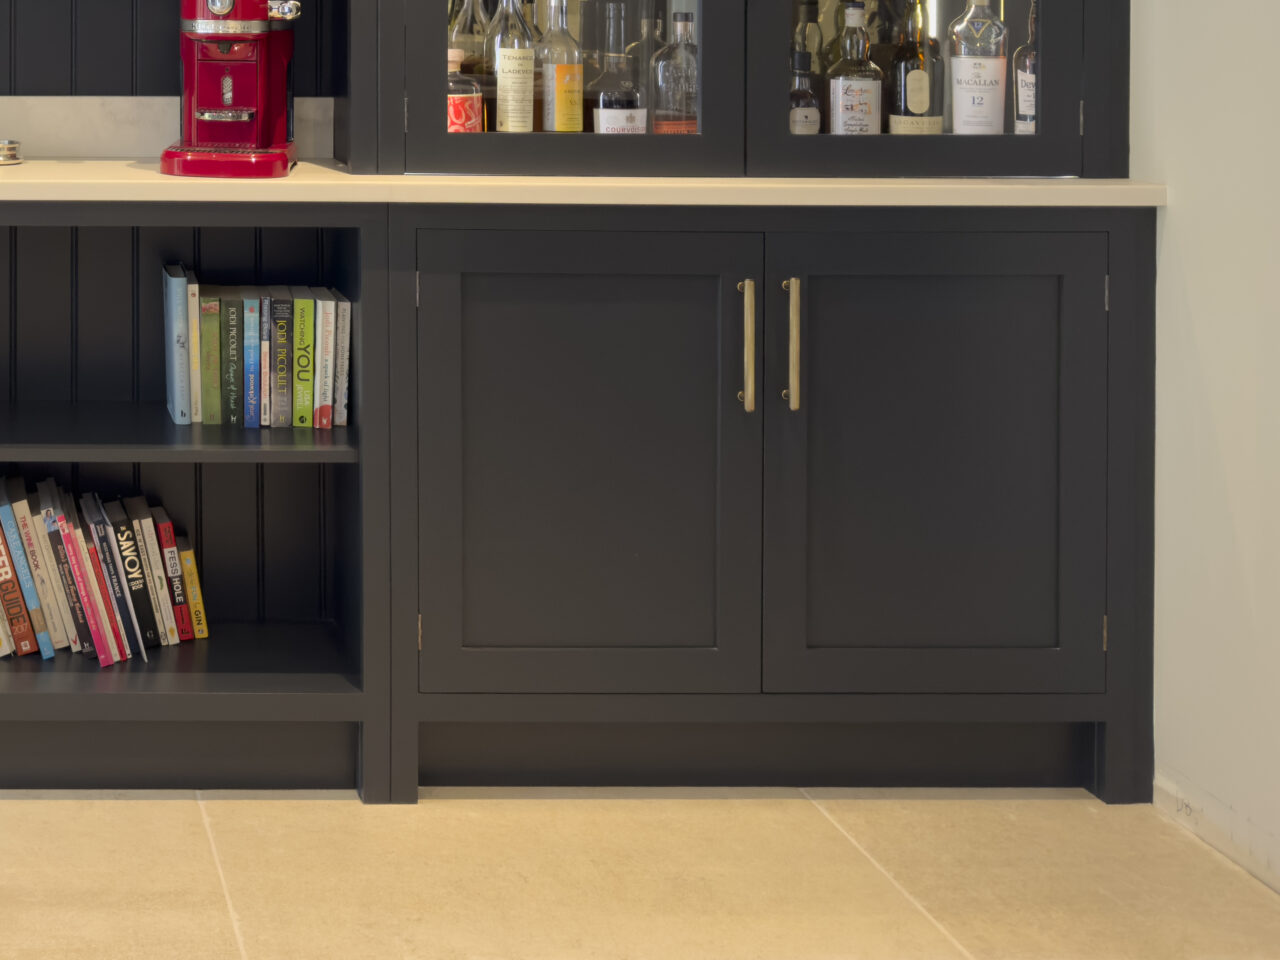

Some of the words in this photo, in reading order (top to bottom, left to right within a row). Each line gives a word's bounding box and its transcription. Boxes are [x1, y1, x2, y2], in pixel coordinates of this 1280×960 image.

[956, 79, 1000, 87] MACALLAN
[971, 95, 984, 106] 12
[228, 307, 237, 324] JODI
[277, 320, 288, 343] JODI
[228, 327, 237, 361] PICOULT
[277, 348, 288, 393] PICOULT
[297, 344, 311, 382] YOU
[20, 515, 28, 530] THE
[23, 530, 34, 549] WINE
[29, 550, 41, 571] BOOK
[117, 531, 143, 579] SAVOY
[168, 550, 179, 575] FESS
[111, 575, 122, 598] FRANCE
[172, 577, 185, 603] HOLE
[0, 580, 26, 627] GUIDE
[194, 609, 204, 626] GIN
